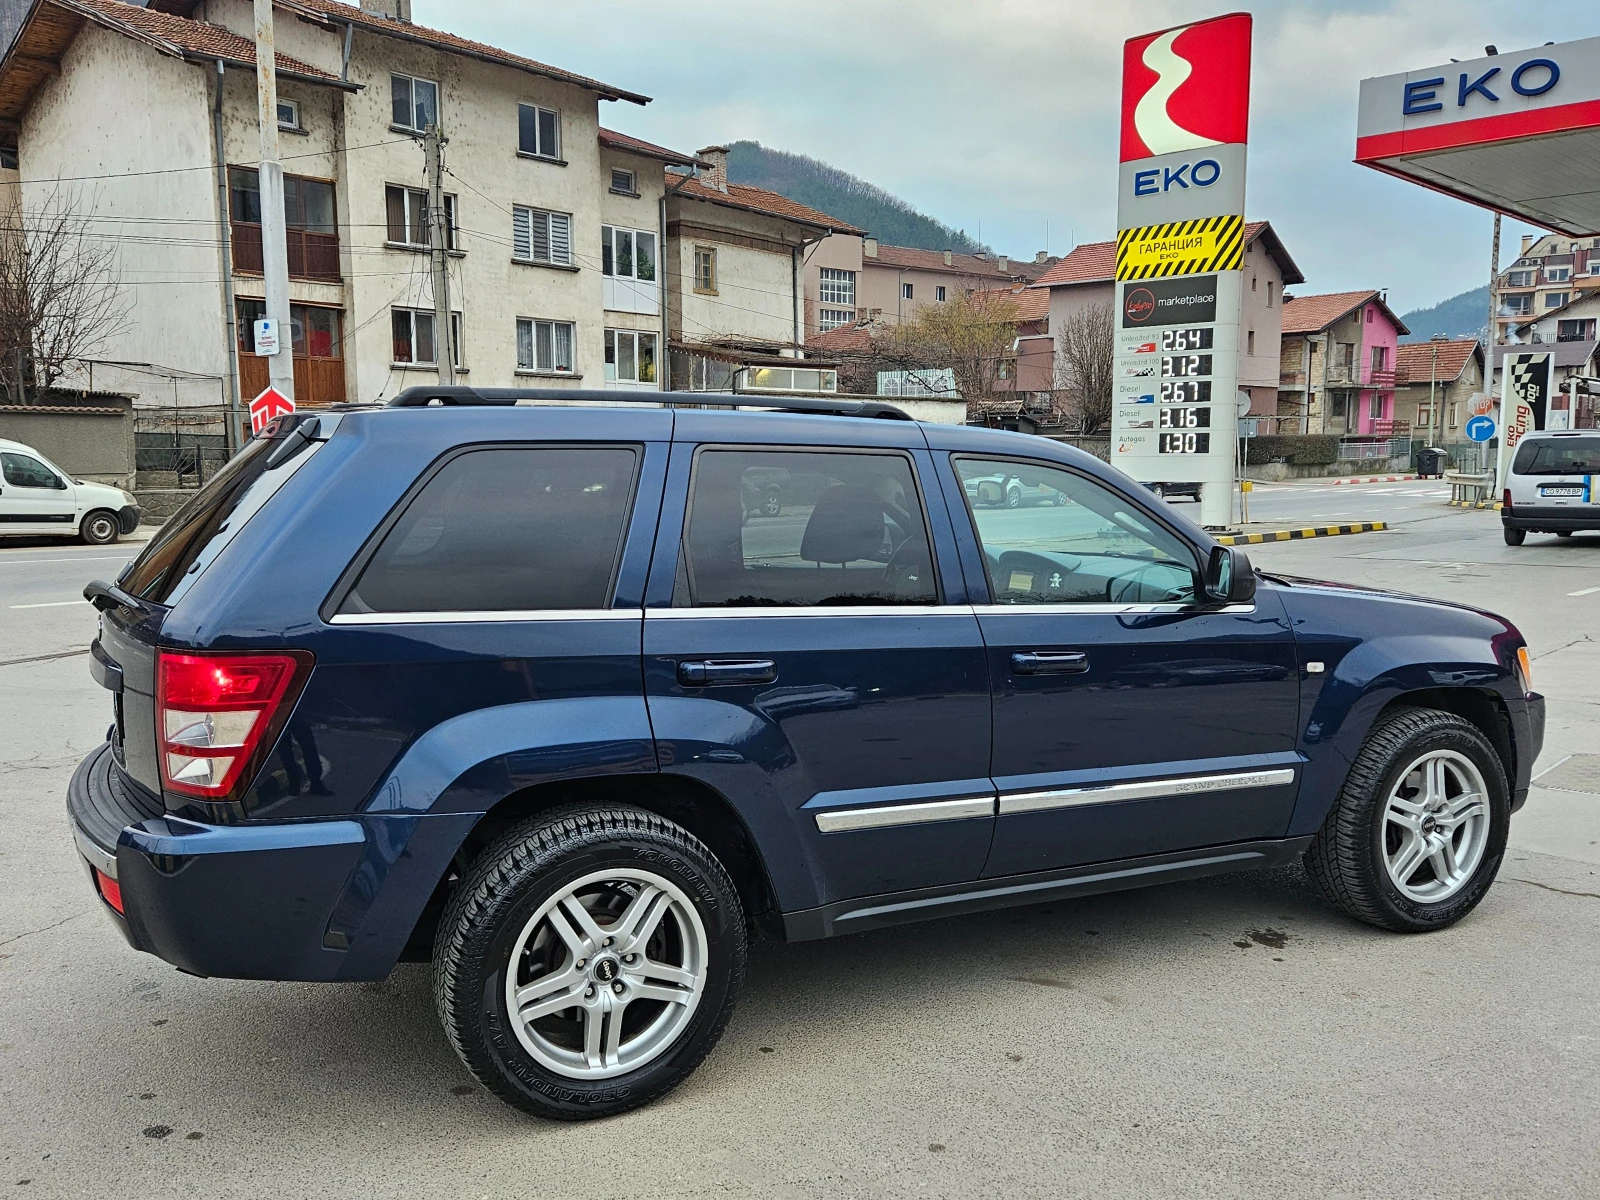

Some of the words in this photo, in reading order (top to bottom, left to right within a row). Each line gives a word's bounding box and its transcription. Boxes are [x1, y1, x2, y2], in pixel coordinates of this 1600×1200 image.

[1403, 58, 1560, 115] EKO
[1134, 159, 1220, 197] EKO
[1139, 236, 1203, 254] ГАРАНЦИЯ
[1159, 252, 1179, 260] EKO
[1158, 294, 1214, 307] marketplace
[1121, 334, 1150, 342] Unleaded
[1162, 330, 1201, 351] 2.64
[1120, 359, 1148, 367] Unleaded
[1162, 355, 1200, 377] 3.12
[1119, 385, 1141, 393] Diesel
[1161, 381, 1199, 403] 2.67
[1526, 383, 1537, 403] 100
[1161, 407, 1198, 428] 3.16
[1165, 433, 1197, 453] 1.30
[1506, 425, 1516, 447] EKO
[1175, 781, 1215, 792] GRAND
[1217, 775, 1271, 788] CHEROKEE
[632, 848, 718, 911] YOKOHAMA
[602, 960, 613, 979] Jeep
[507, 1057, 632, 1103] GEOLANDAR
